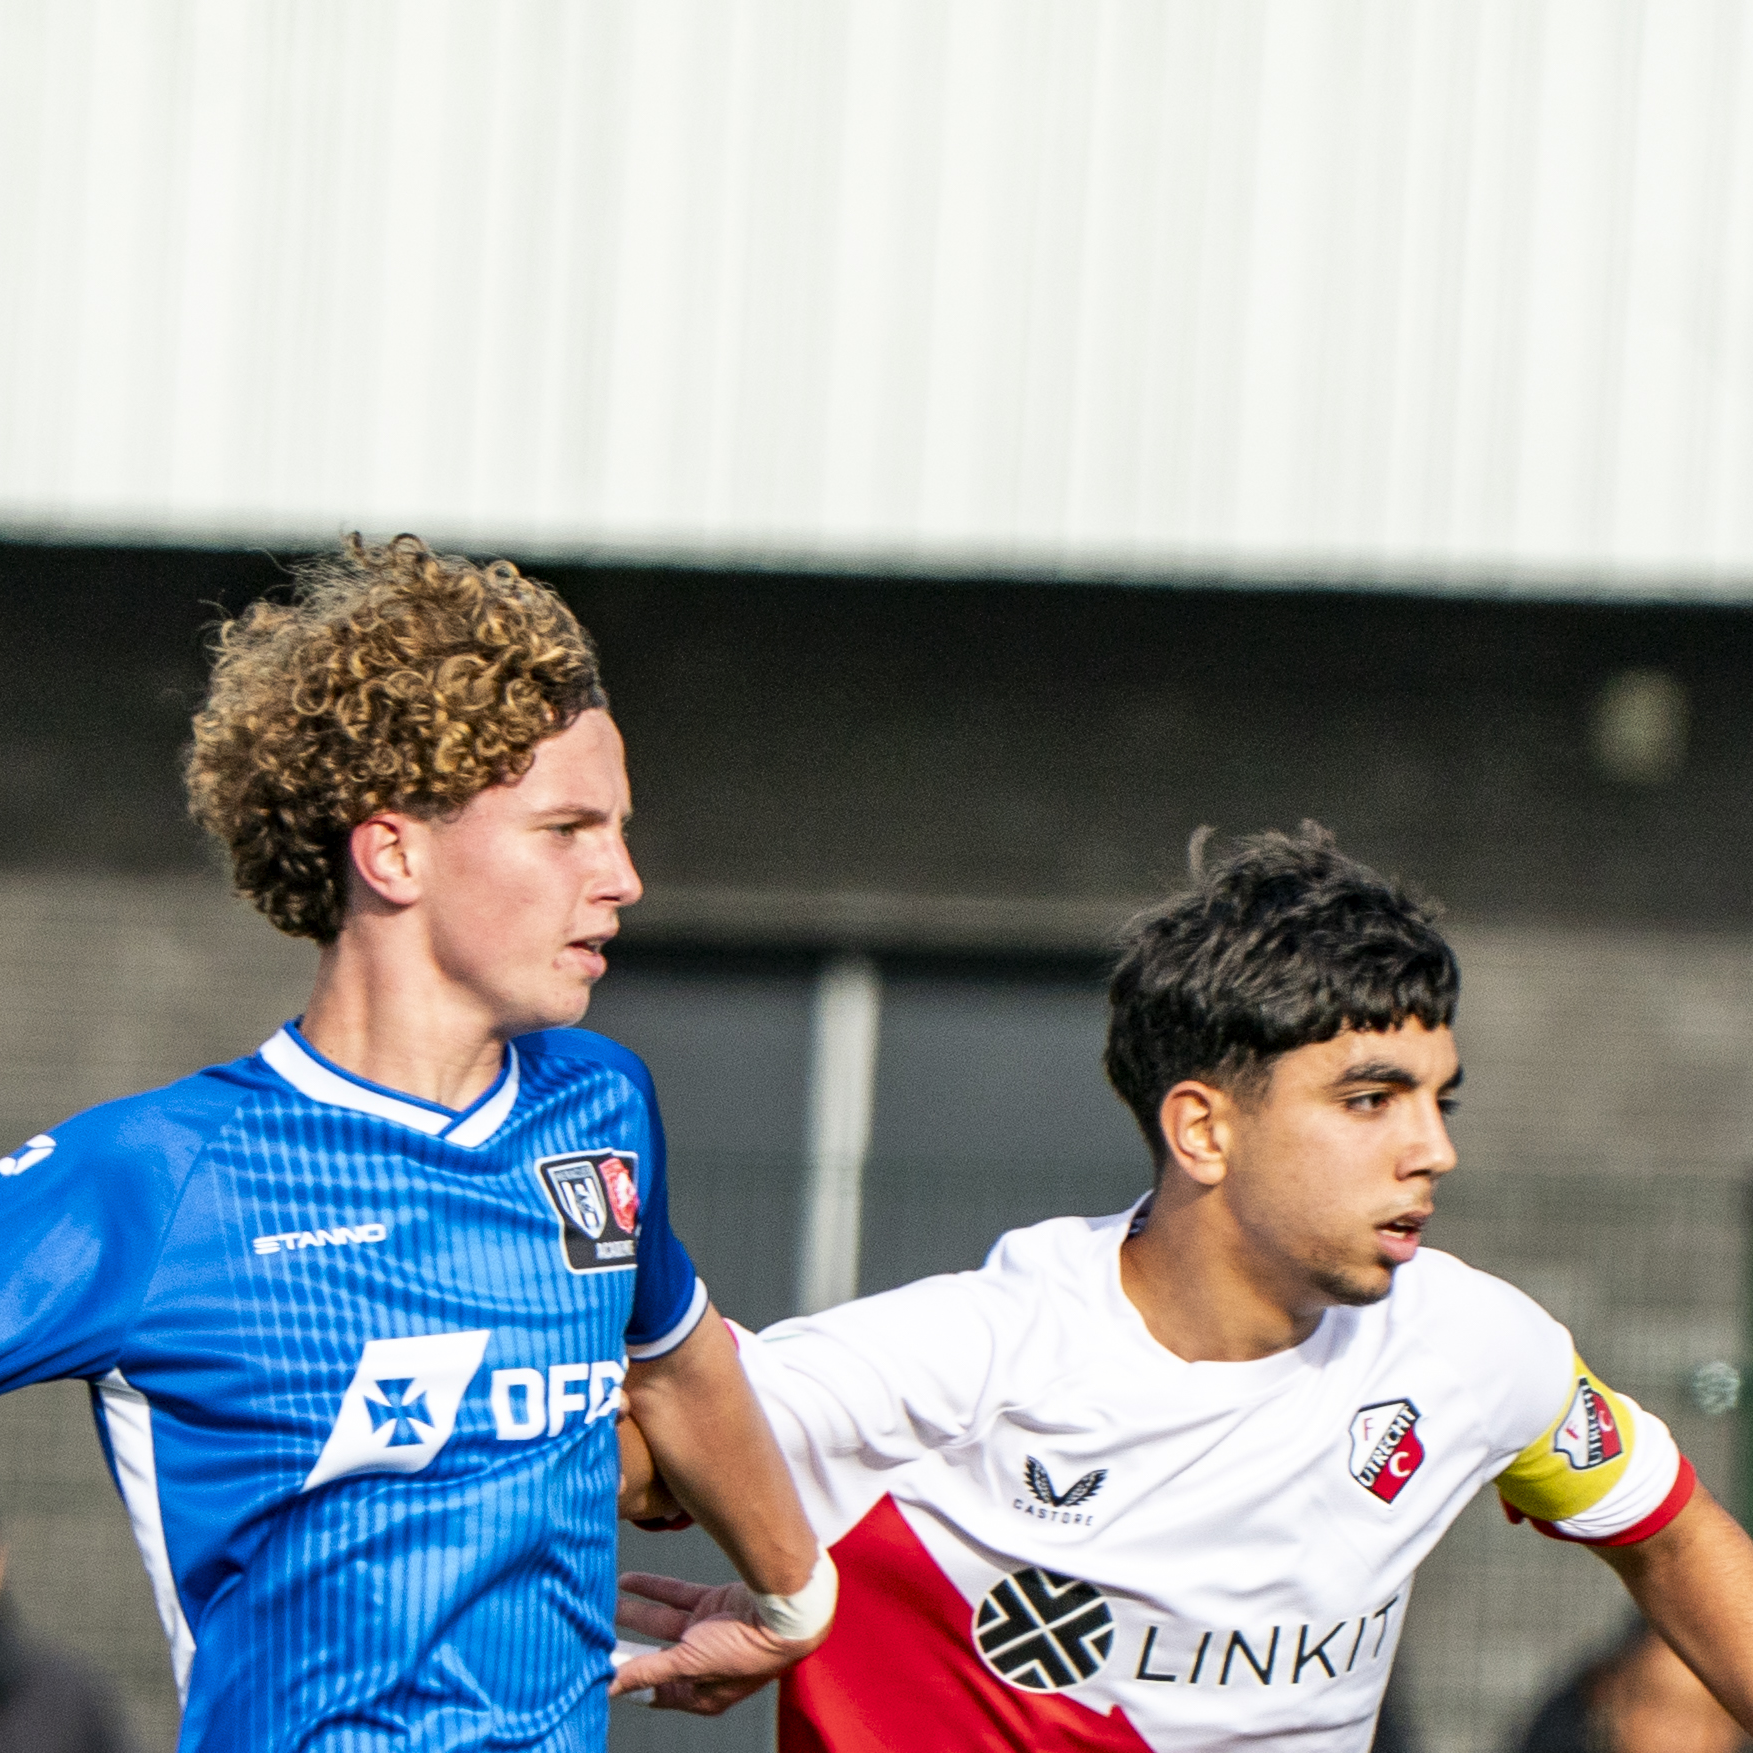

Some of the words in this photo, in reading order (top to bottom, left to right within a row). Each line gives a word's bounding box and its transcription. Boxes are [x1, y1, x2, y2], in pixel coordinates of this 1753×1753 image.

[253, 1223, 387, 1255] STANNO
[490, 1359, 629, 1441] DFD
[1388, 1450, 1412, 1478] C
[1012, 1498, 1094, 1527] CASTORE
[1135, 1595, 1399, 1687] LINKIT
